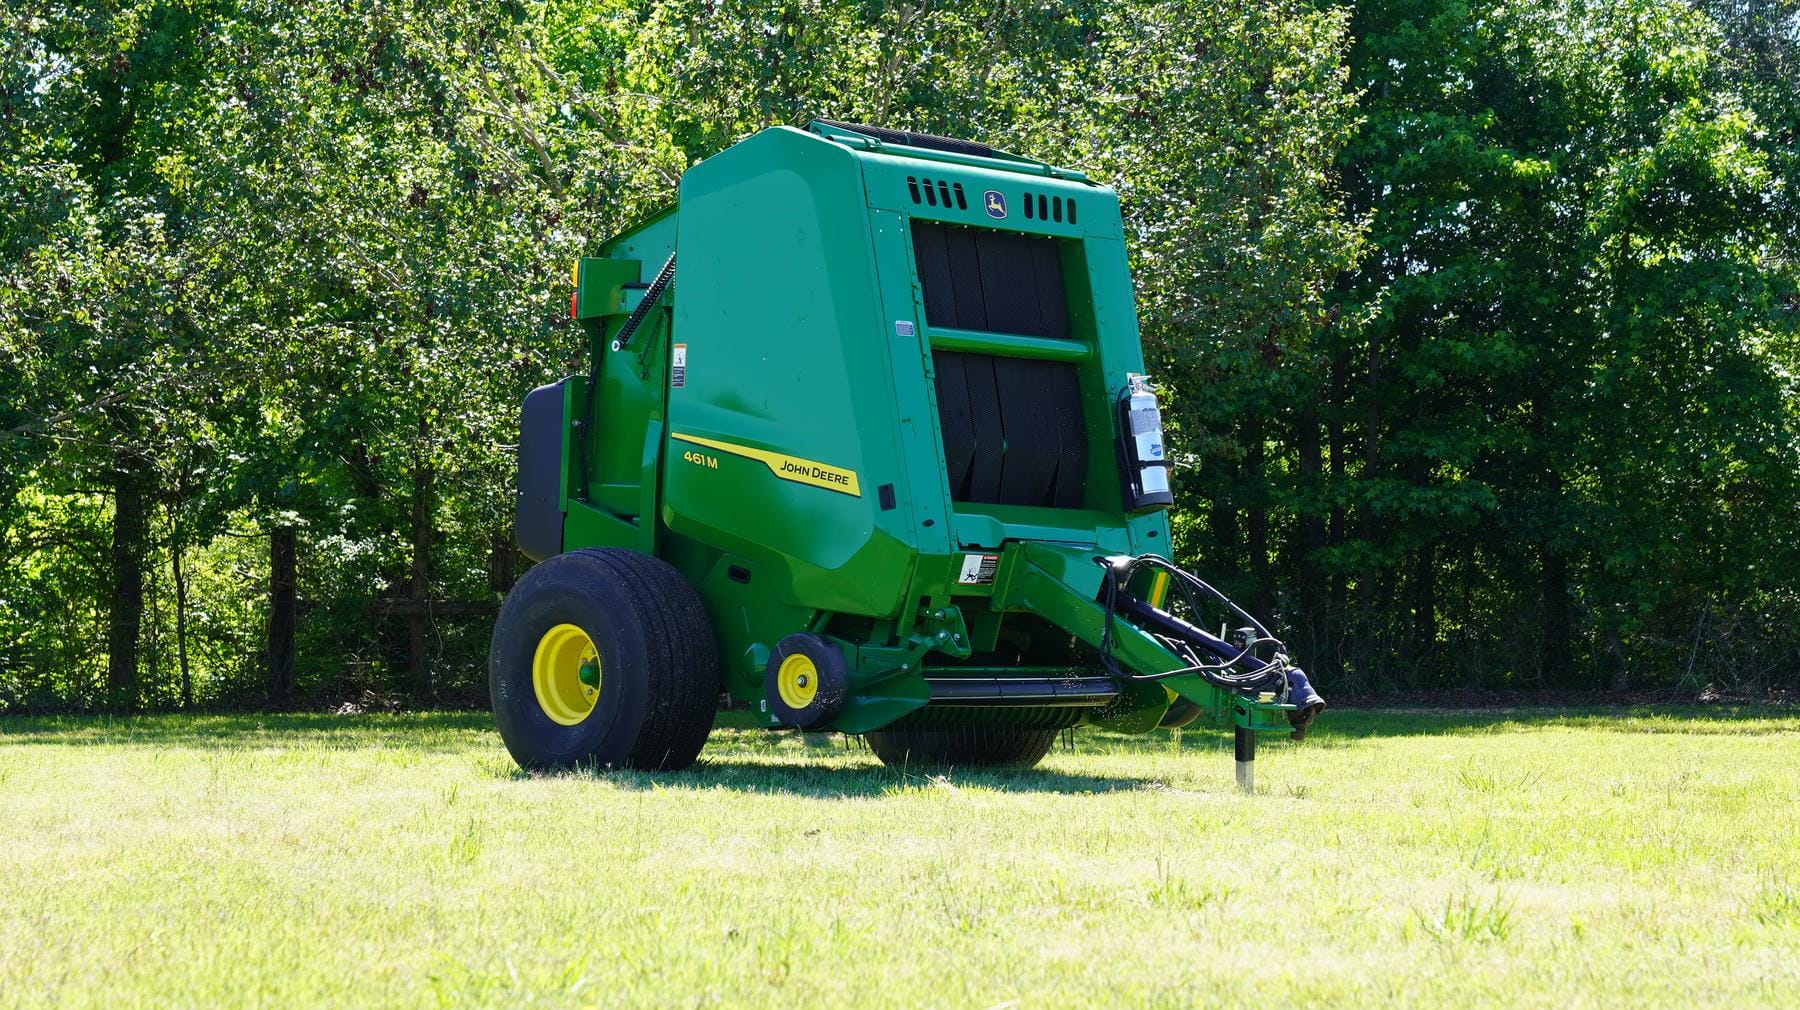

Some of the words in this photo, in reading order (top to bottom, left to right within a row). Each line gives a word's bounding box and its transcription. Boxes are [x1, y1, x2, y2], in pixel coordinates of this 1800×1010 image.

[684, 451, 705, 465] 461
[780, 461, 810, 476] JOHN
[812, 467, 849, 485] DEERE
